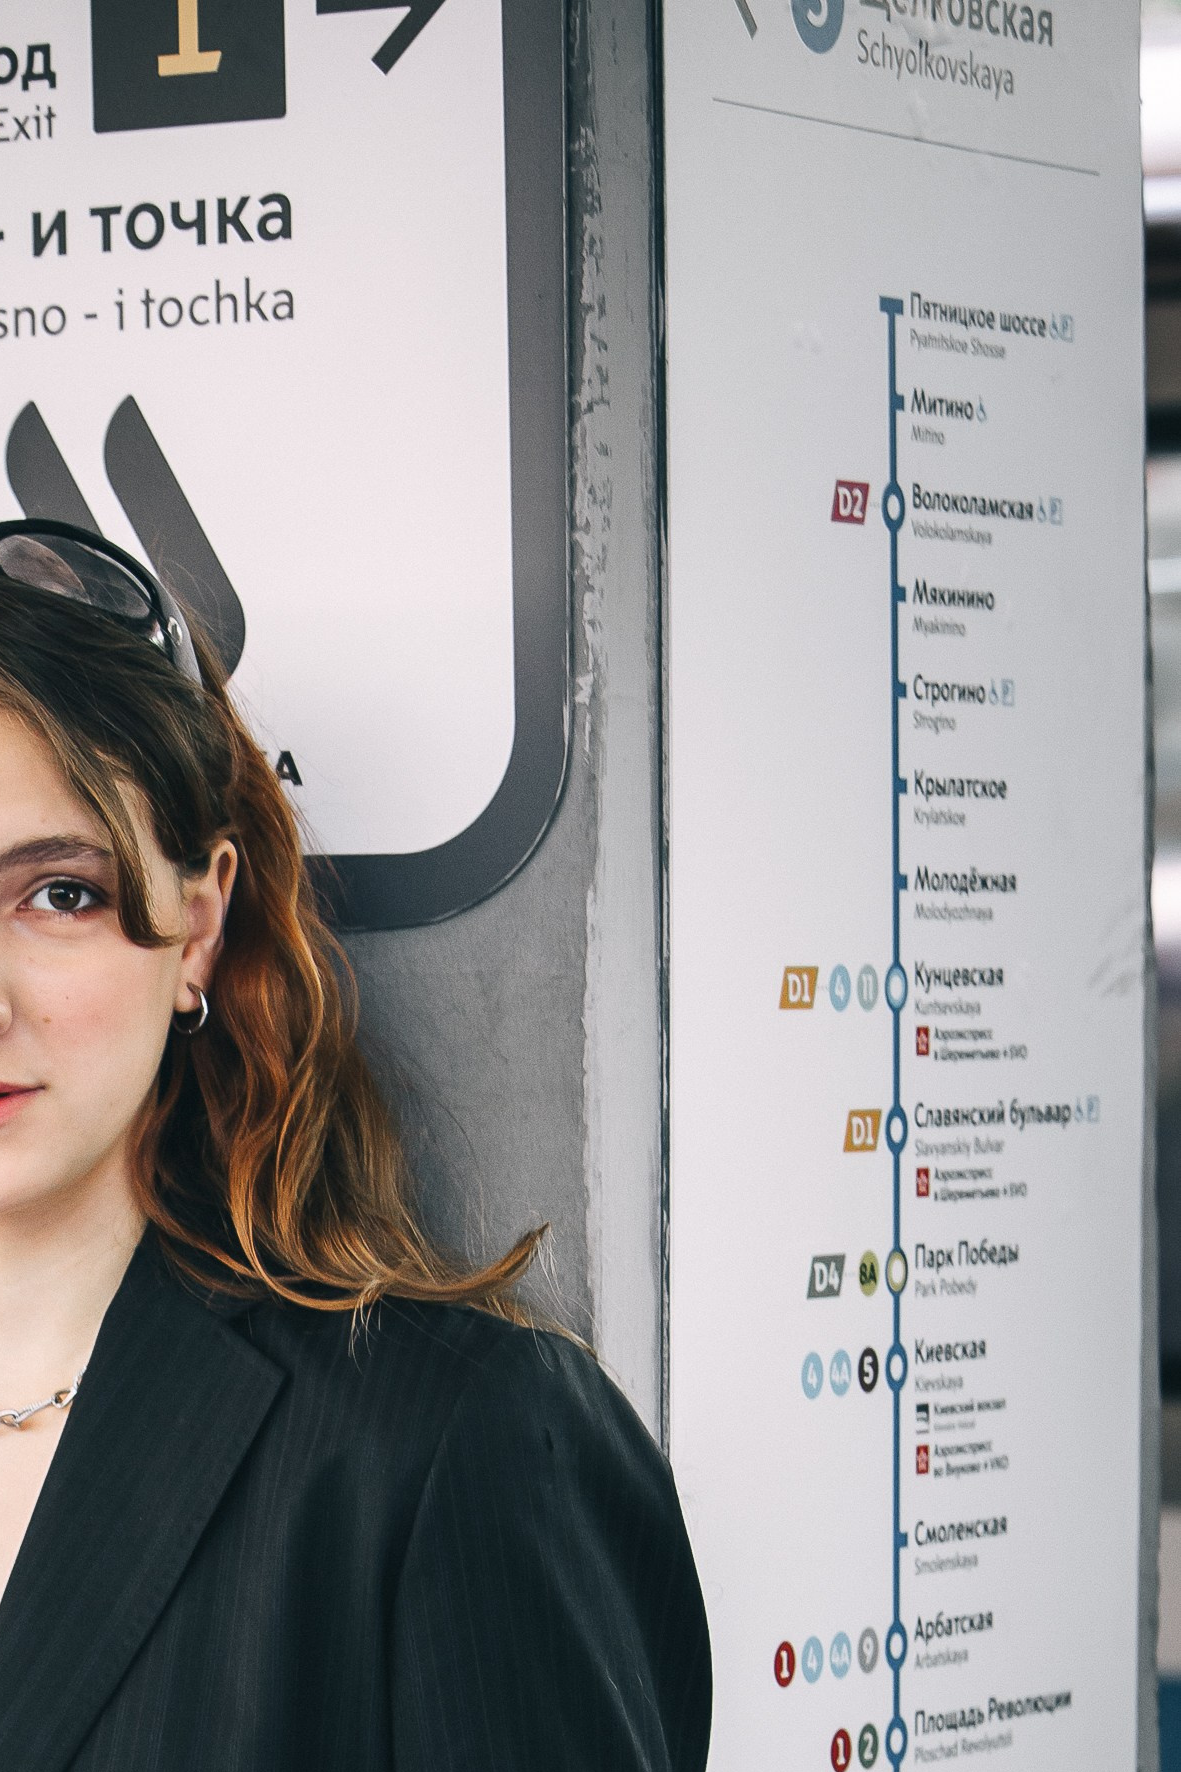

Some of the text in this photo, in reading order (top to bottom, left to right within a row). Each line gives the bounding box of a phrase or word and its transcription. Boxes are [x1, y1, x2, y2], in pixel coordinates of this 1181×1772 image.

[157, 0, 222, 77] 1
[860, 0, 1054, 47] ковская
[857, 29, 1014, 100] Schyolkovskaya
[31, 209, 69, 258] и
[90, 191, 294, 252] точка
[114, 288, 126, 332] i
[141, 278, 296, 328] tochka
[910, 291, 1047, 338] Пятницкое шоссе
[910, 387, 974, 422] Митино
[837, 486, 865, 519] D2
[912, 483, 1034, 520] Волоколамская
[913, 578, 996, 611] Мякинино
[914, 674, 987, 707] Строгино
[914, 769, 1008, 802] Крылатское
[915, 865, 1017, 896] Молодёжная
[786, 972, 811, 1004] D1
[915, 961, 1004, 993] Кунцевская
[915, 1099, 1072, 1130] Славянский бульвар
[850, 1116, 875, 1147] D1
[915, 1238, 1020, 1270] Парк Победы
[814, 1261, 840, 1293] D4
[915, 1338, 986, 1366] Киевская
[863, 1355, 875, 1384] 5
[915, 1516, 1007, 1547] Смоленская
[915, 1611, 994, 1645] Арбатская
[915, 1690, 1072, 1737] Площадь Революции
[862, 1732, 874, 1762] 2
